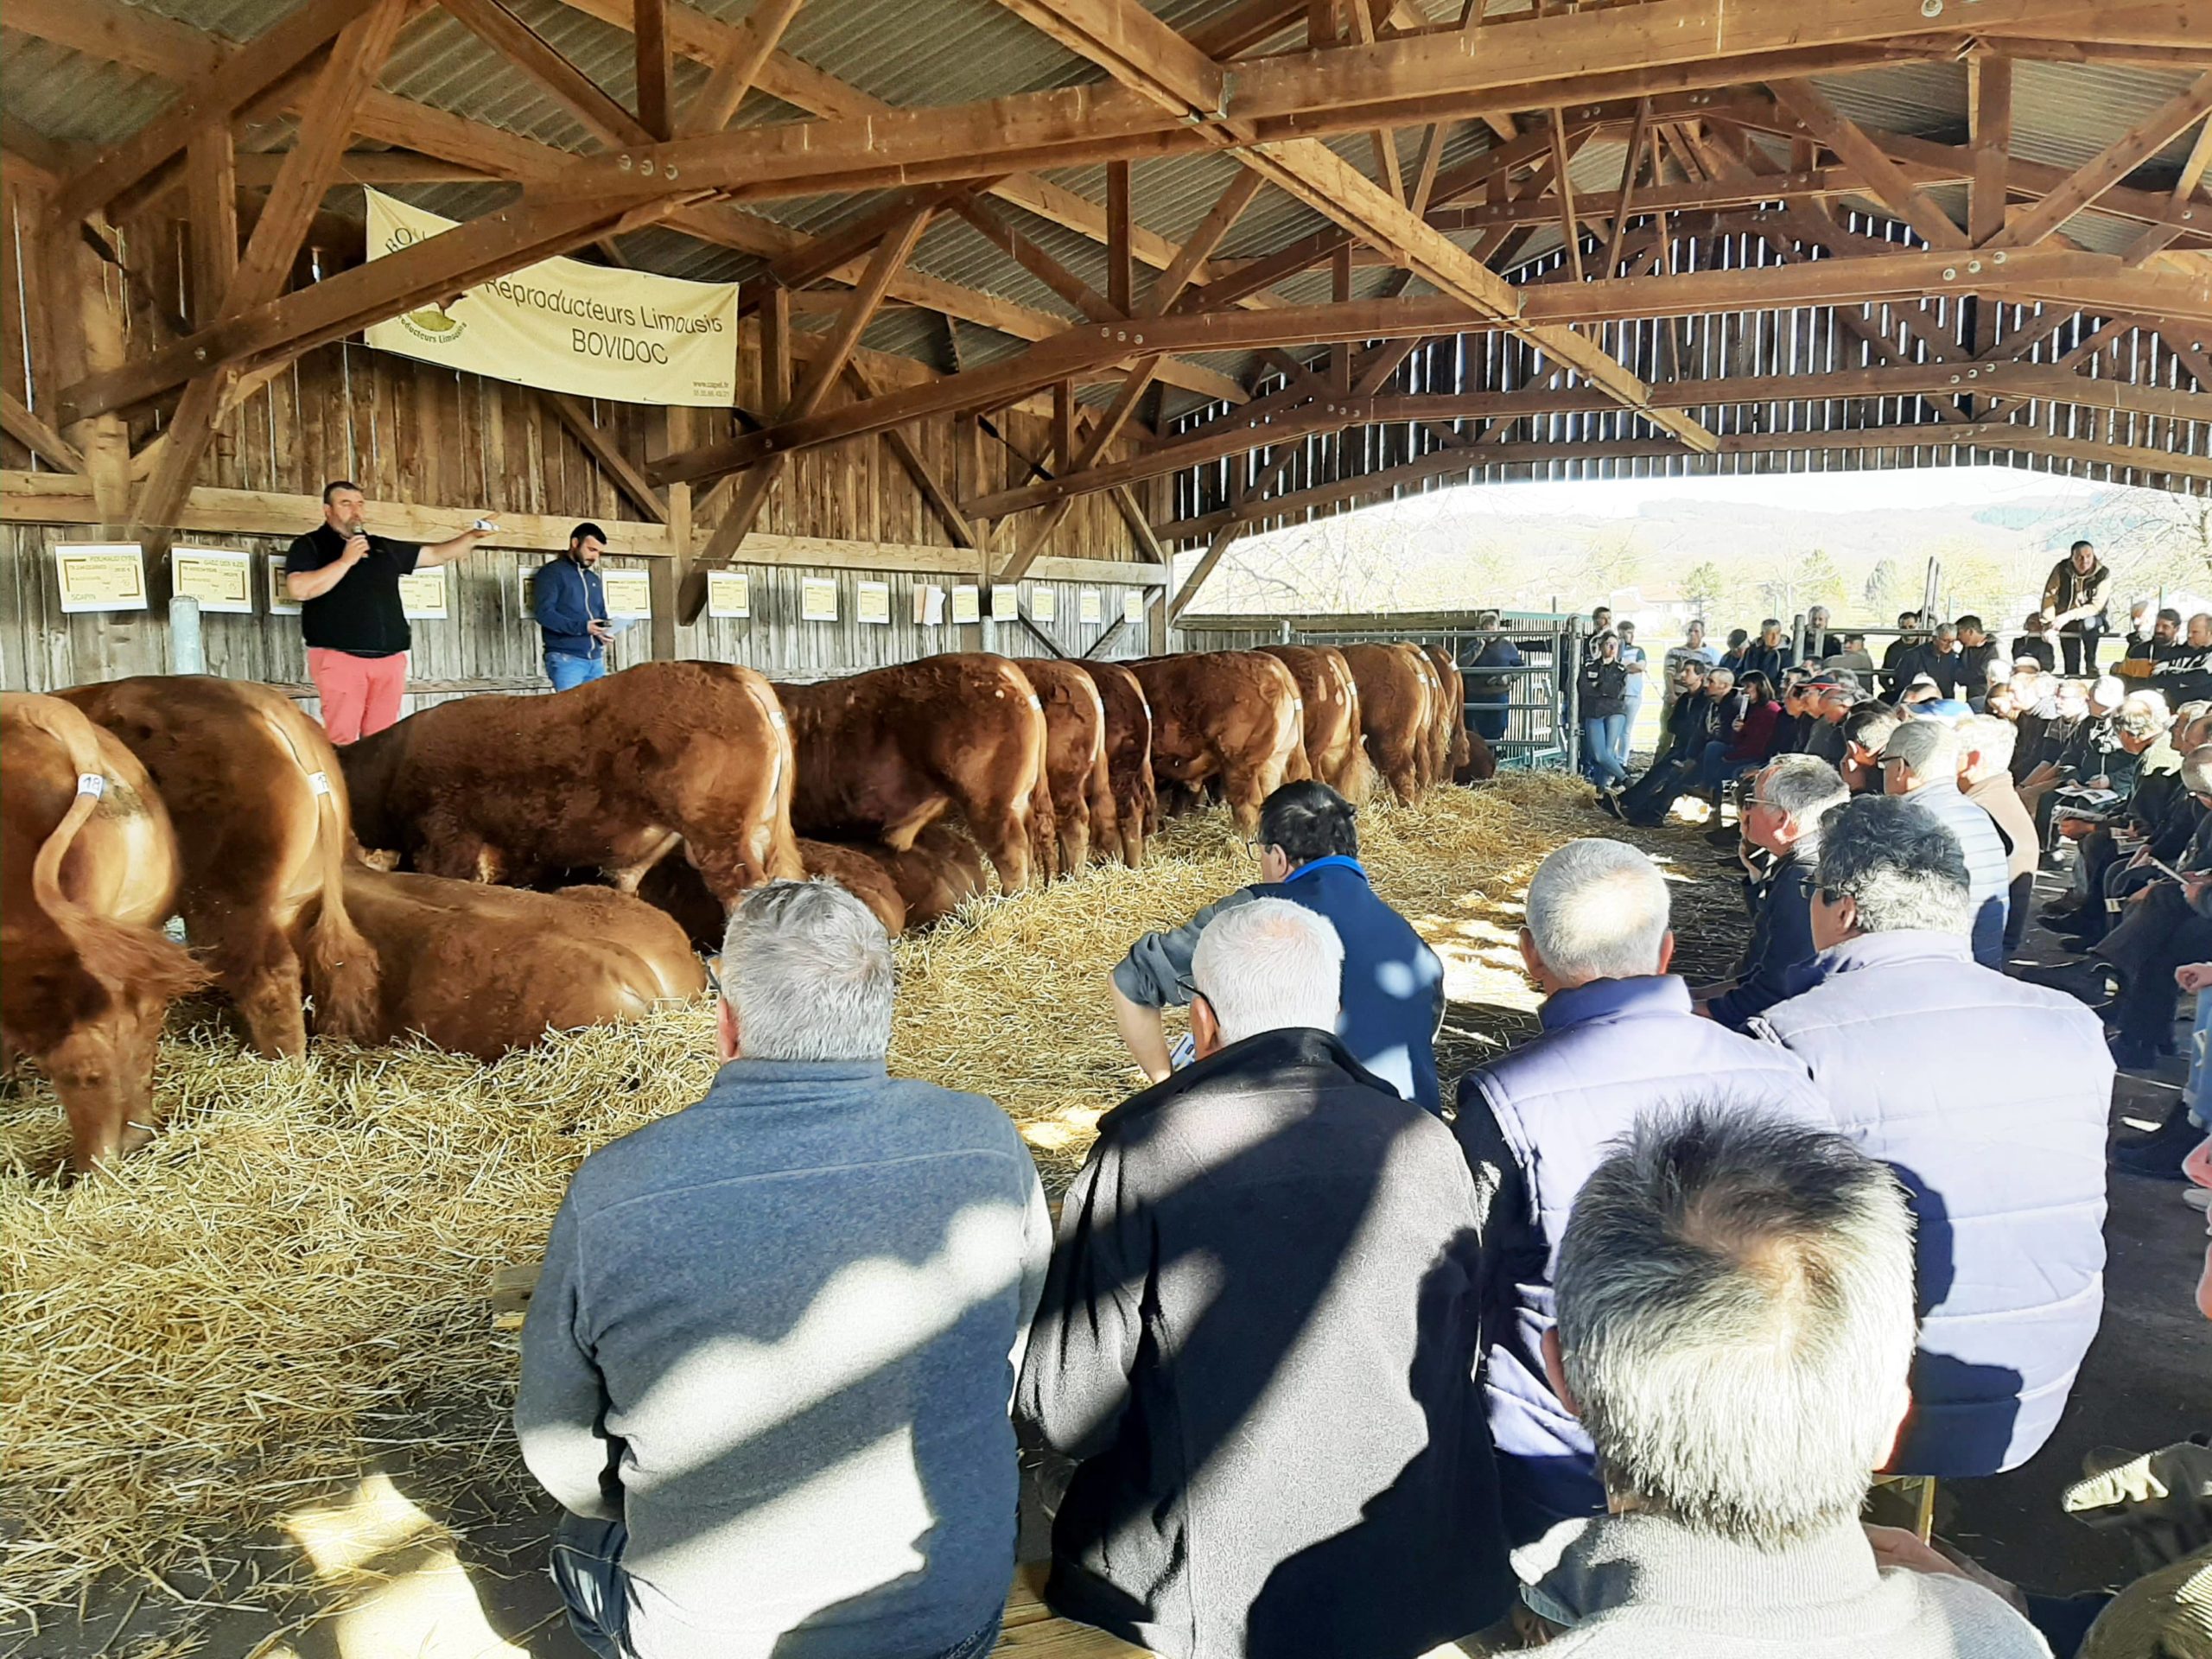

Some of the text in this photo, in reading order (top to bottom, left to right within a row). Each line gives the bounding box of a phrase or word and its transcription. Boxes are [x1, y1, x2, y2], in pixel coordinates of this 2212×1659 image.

[485, 280, 636, 326] Reproducteurs
[572, 328, 668, 365] BOVIDOC
[83, 776, 100, 790] 18
